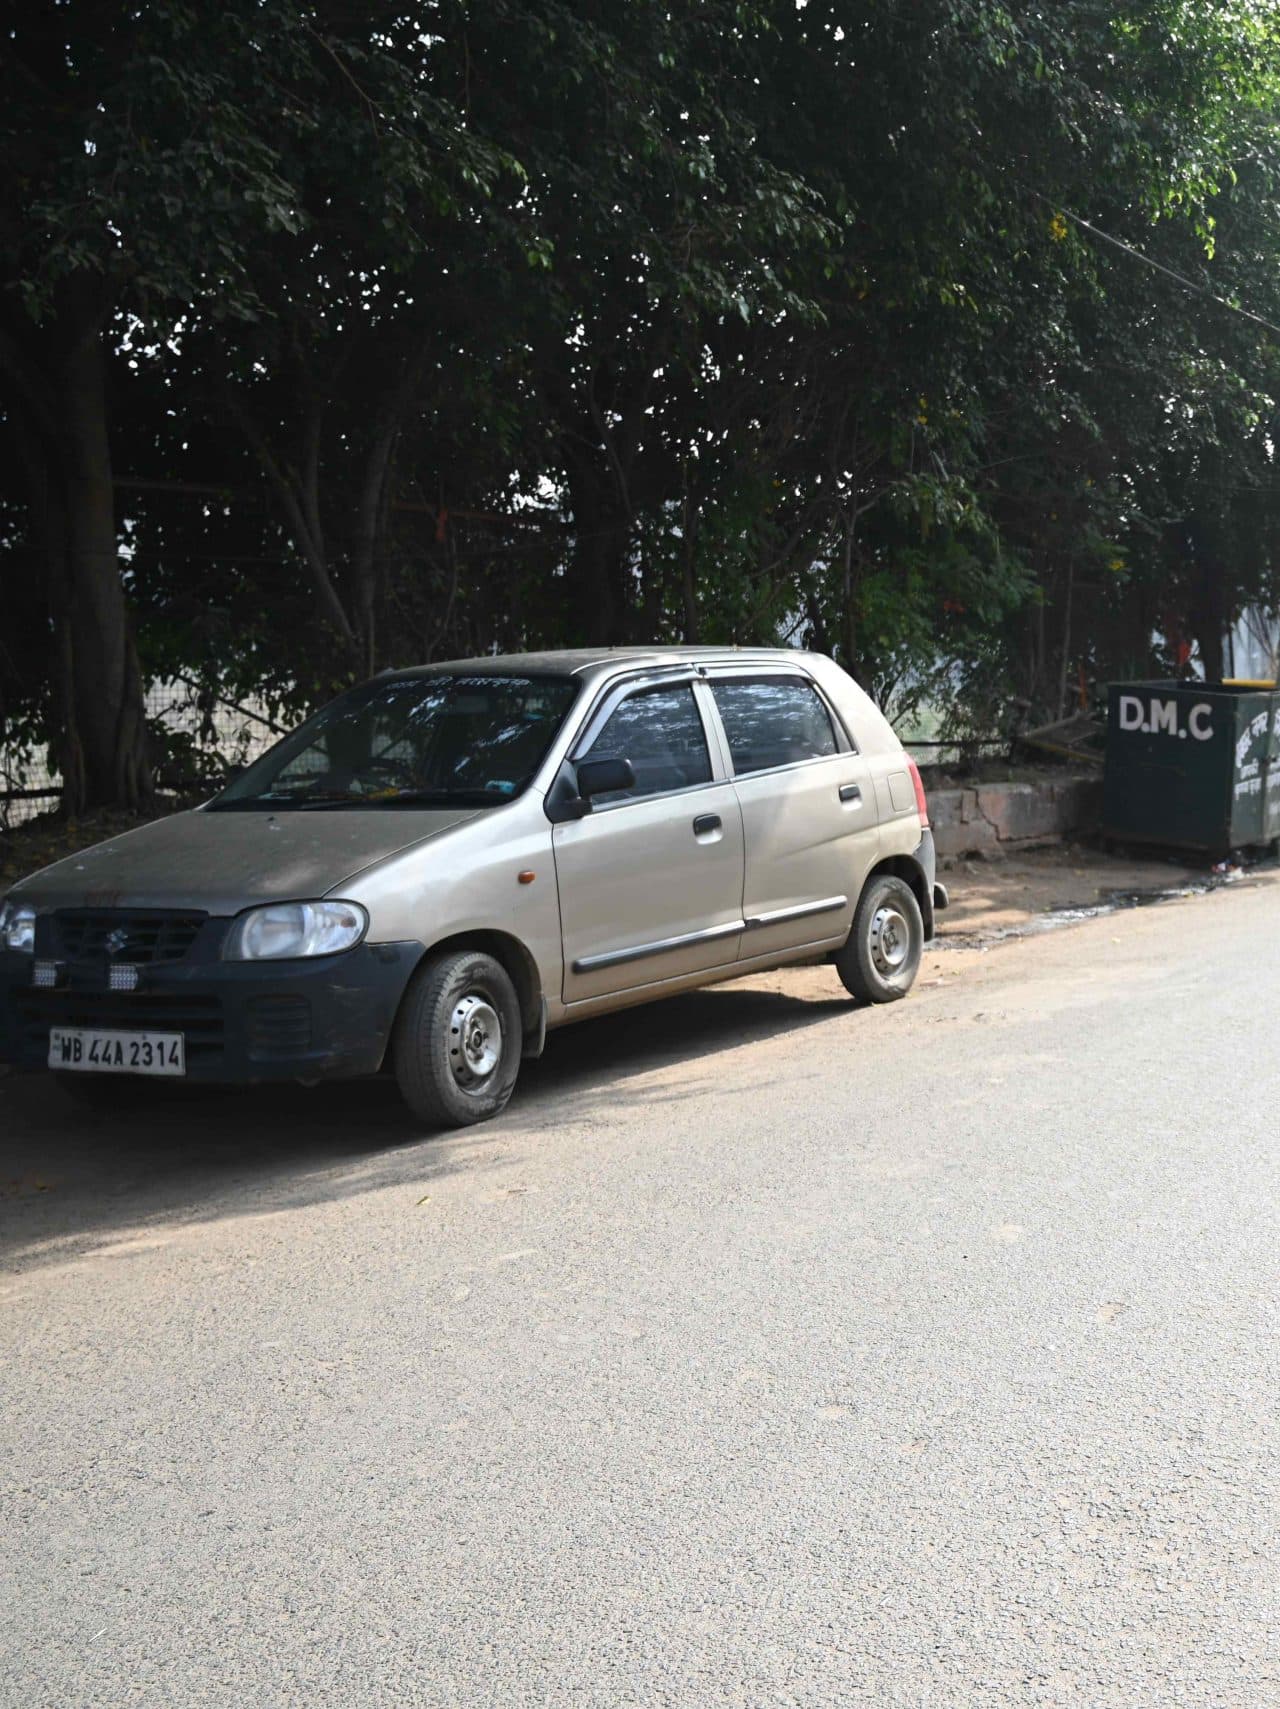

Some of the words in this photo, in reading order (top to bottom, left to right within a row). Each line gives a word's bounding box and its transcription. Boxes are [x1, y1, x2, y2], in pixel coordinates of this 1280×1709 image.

[1119, 695, 1214, 741] D.M.C
[61, 1036, 83, 1063] WB
[88, 1039, 124, 1065] 44A
[130, 1041, 179, 1067] 2314
